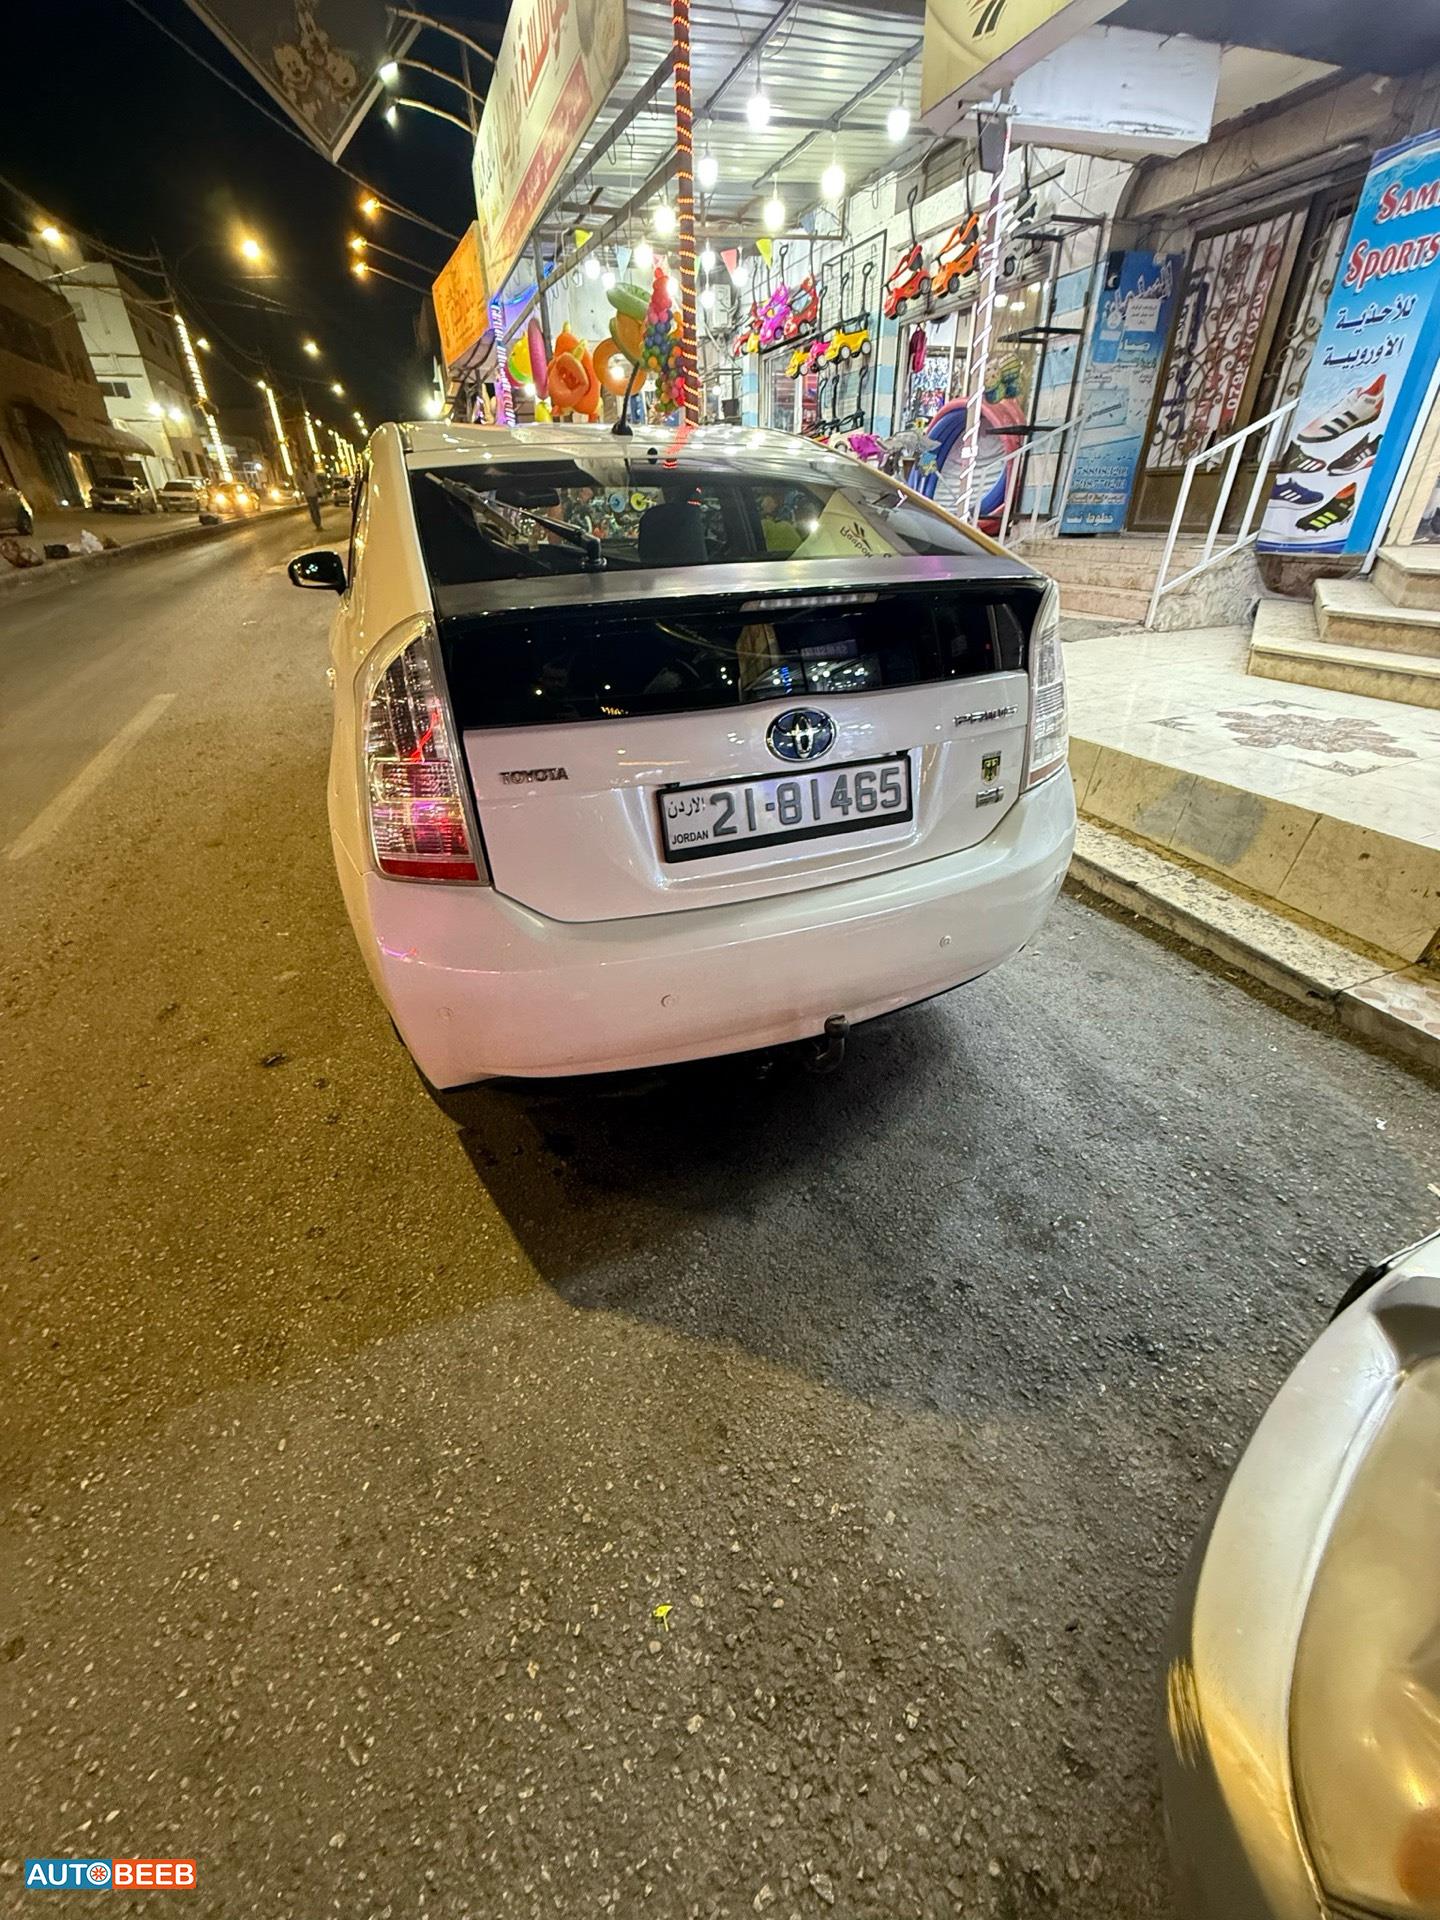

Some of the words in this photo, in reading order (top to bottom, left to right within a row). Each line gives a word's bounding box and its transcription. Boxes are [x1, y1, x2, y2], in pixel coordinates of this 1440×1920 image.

[1344, 232, 1440, 293] SPORTS
[1336, 294, 1417, 333] للأحذية
[1323, 335, 1405, 369] الأوروبية
[499, 767, 569, 784] TOYOTA
[709, 766, 901, 838] 21-81465
[671, 830, 709, 845] JORDAN
